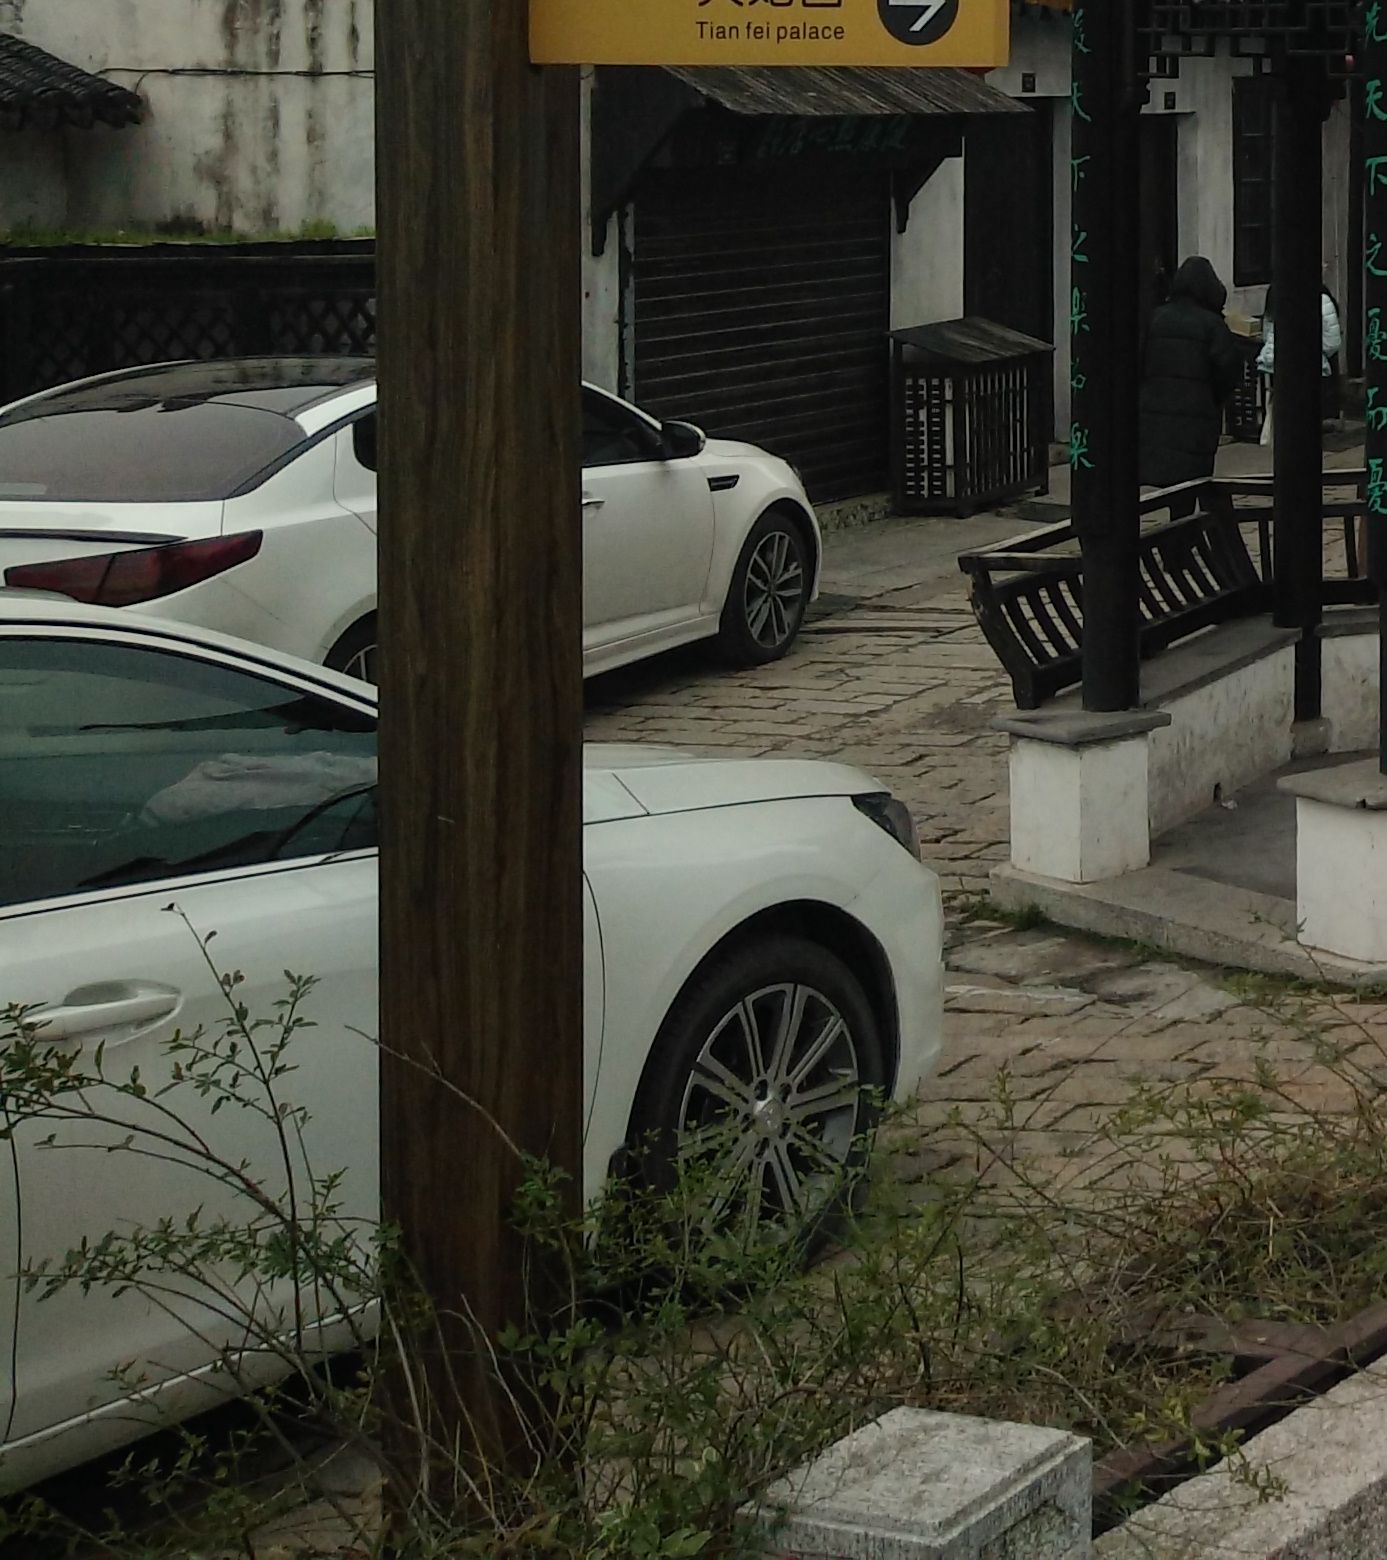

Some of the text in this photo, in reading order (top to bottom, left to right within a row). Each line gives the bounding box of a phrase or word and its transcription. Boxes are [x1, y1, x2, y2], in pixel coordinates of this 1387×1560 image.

[695, 21, 844, 43] Tian fei palace
